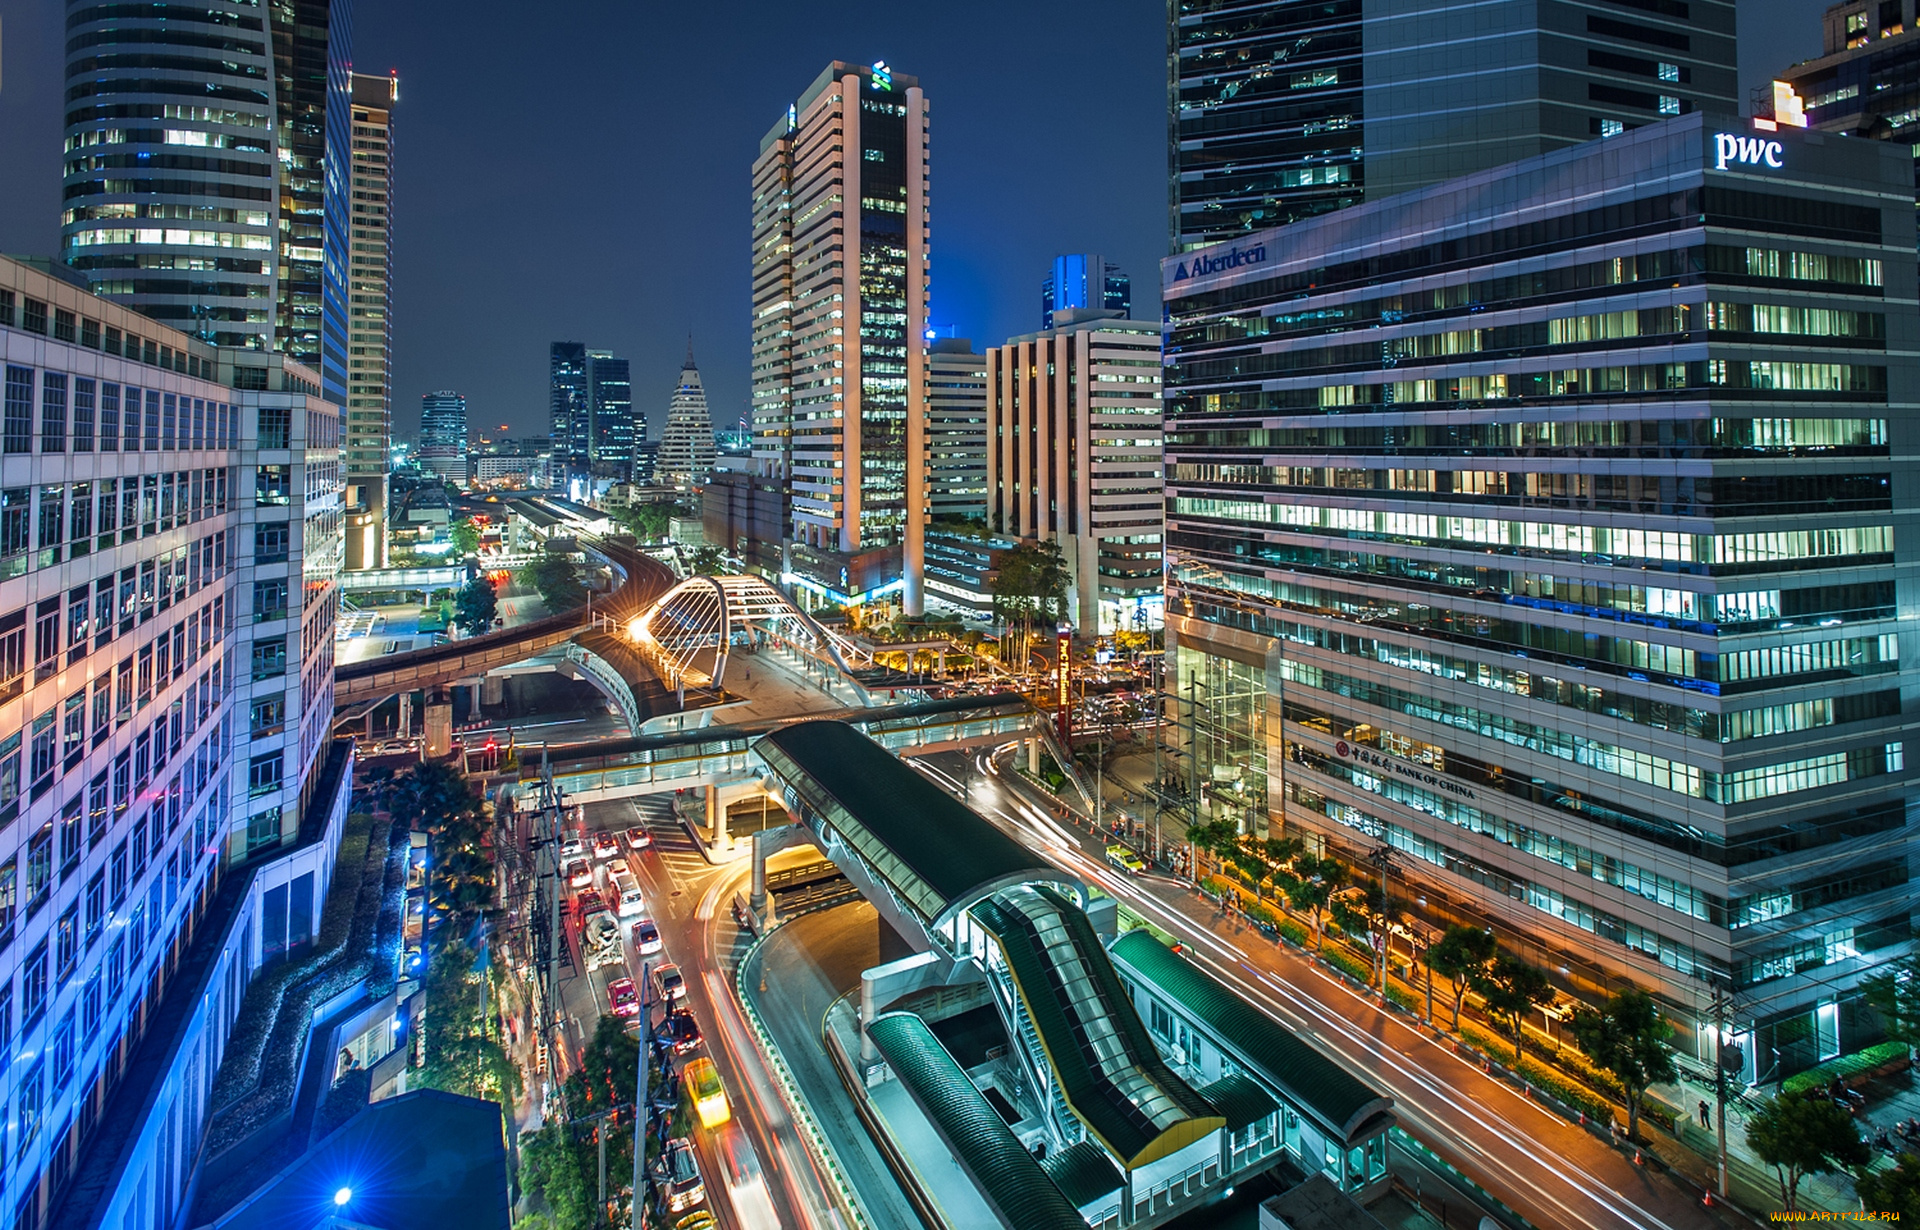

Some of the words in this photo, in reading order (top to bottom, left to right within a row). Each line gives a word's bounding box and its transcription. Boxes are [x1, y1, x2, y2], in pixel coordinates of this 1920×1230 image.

[1714, 132, 1783, 170] pwc
[1190, 245, 1266, 278] Aberdeen
[1395, 764, 1425, 781] BANK
[1423, 774, 1438, 787] OF
[1439, 780, 1476, 800] CHINA
